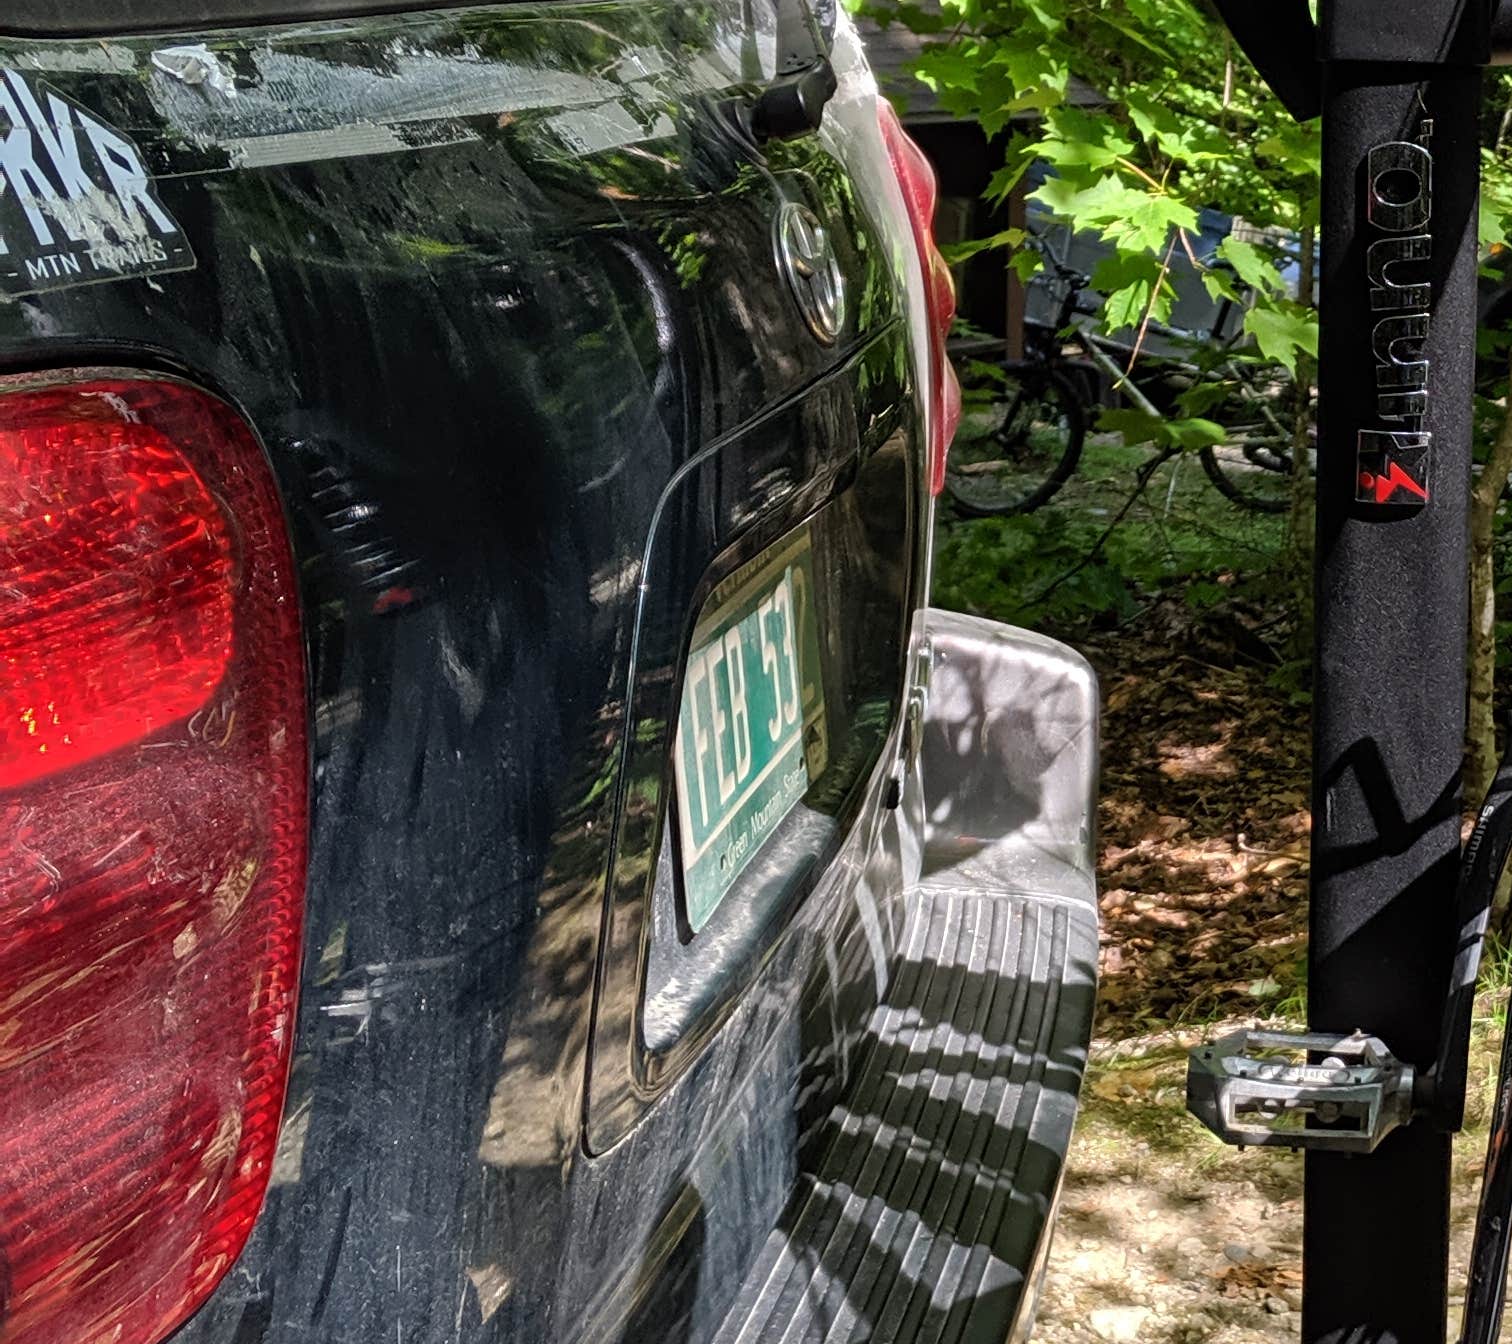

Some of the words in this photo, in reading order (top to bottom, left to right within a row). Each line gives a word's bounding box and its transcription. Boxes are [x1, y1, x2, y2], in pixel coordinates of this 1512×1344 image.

[25, 250, 82, 281] MTN
[689, 624, 751, 828] FEB
[757, 567, 815, 743] 532
[726, 831, 749, 867] Green
[750, 791, 782, 839] Mountain
[783, 767, 805, 798] State
